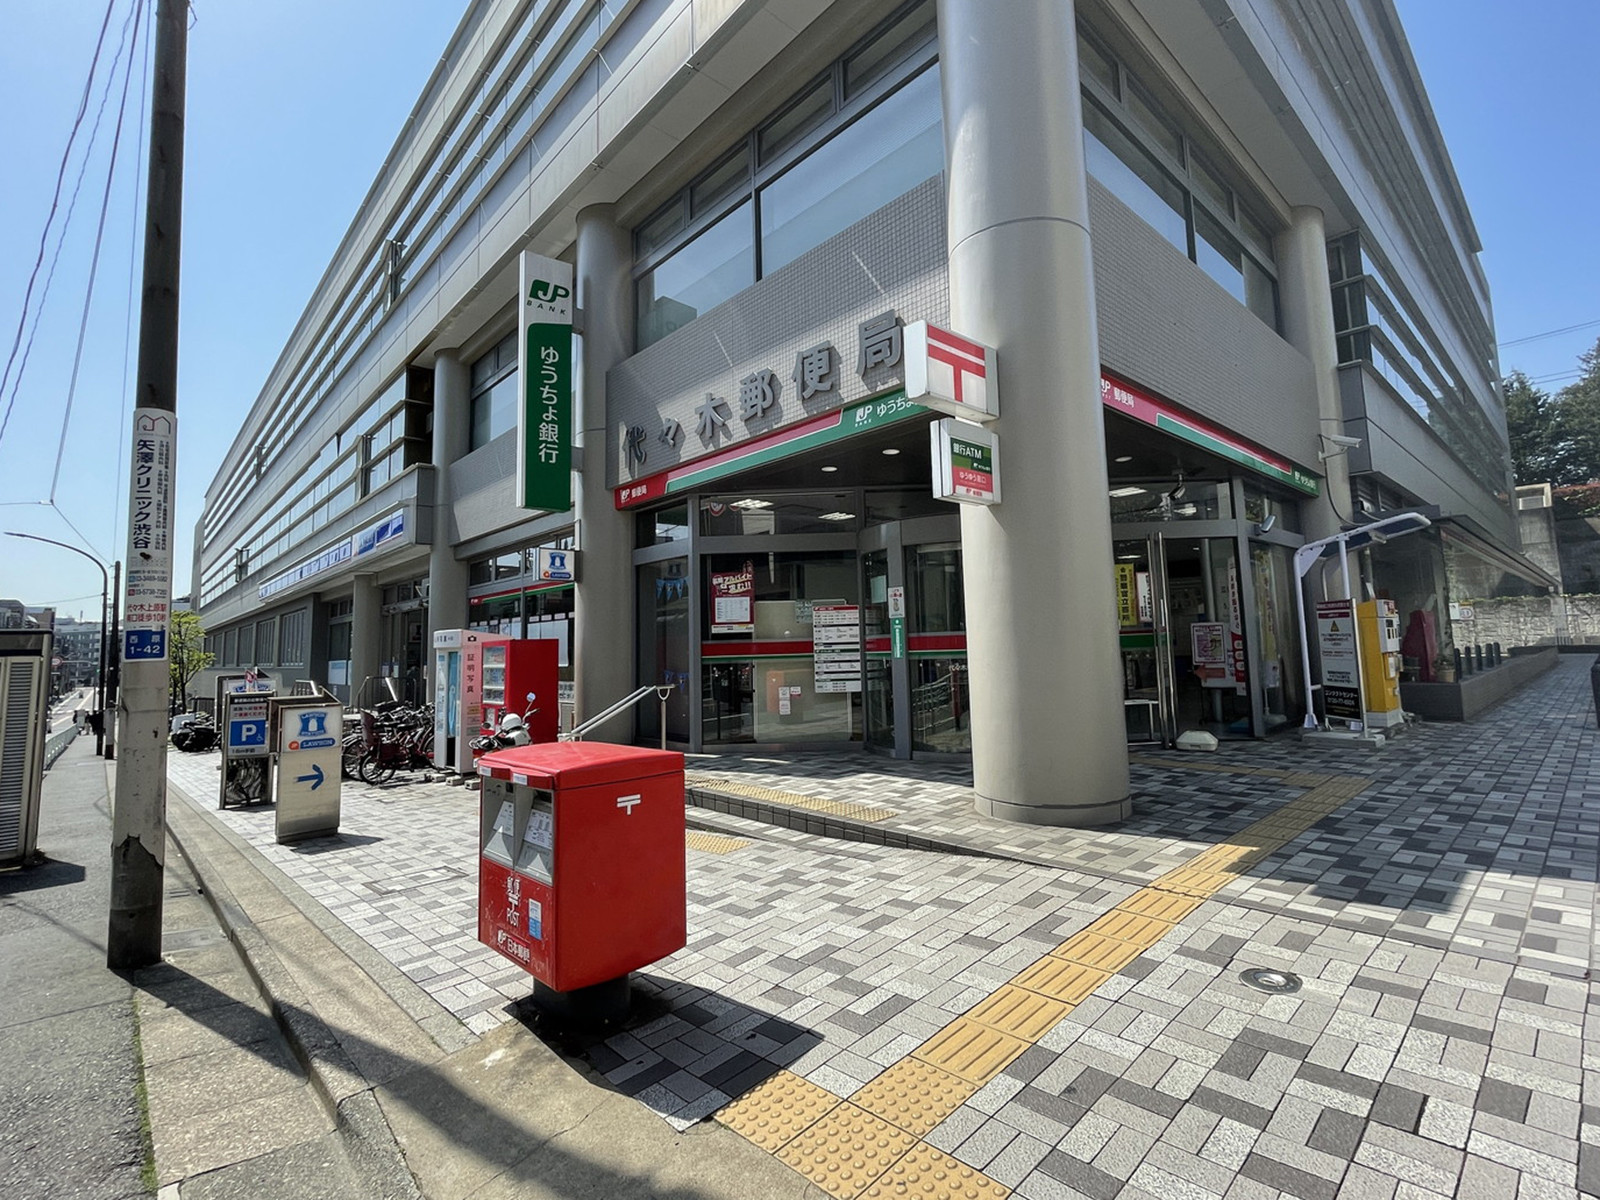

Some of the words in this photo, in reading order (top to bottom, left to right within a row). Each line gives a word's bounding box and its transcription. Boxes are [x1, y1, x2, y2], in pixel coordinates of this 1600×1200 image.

[529, 279, 570, 303] JP
[526, 299, 566, 315] BANK
[624, 309, 902, 471] 代々木郵便局
[1114, 386, 1135, 408] 郵便局
[539, 346, 559, 464] ゆうちょ銀行
[953, 442, 982, 459] 銀行ATM
[133, 439, 155, 549] 矢澤クリニック渋谷
[631, 484, 648, 498] 郵便局
[129, 645, 160, 654] 1-42
[466, 653, 475, 693] 証明写真
[241, 724, 257, 741] P
[302, 740, 333, 748] LAWSON
[506, 908, 520, 928] POST
[507, 939, 531, 963] 日本郵便
